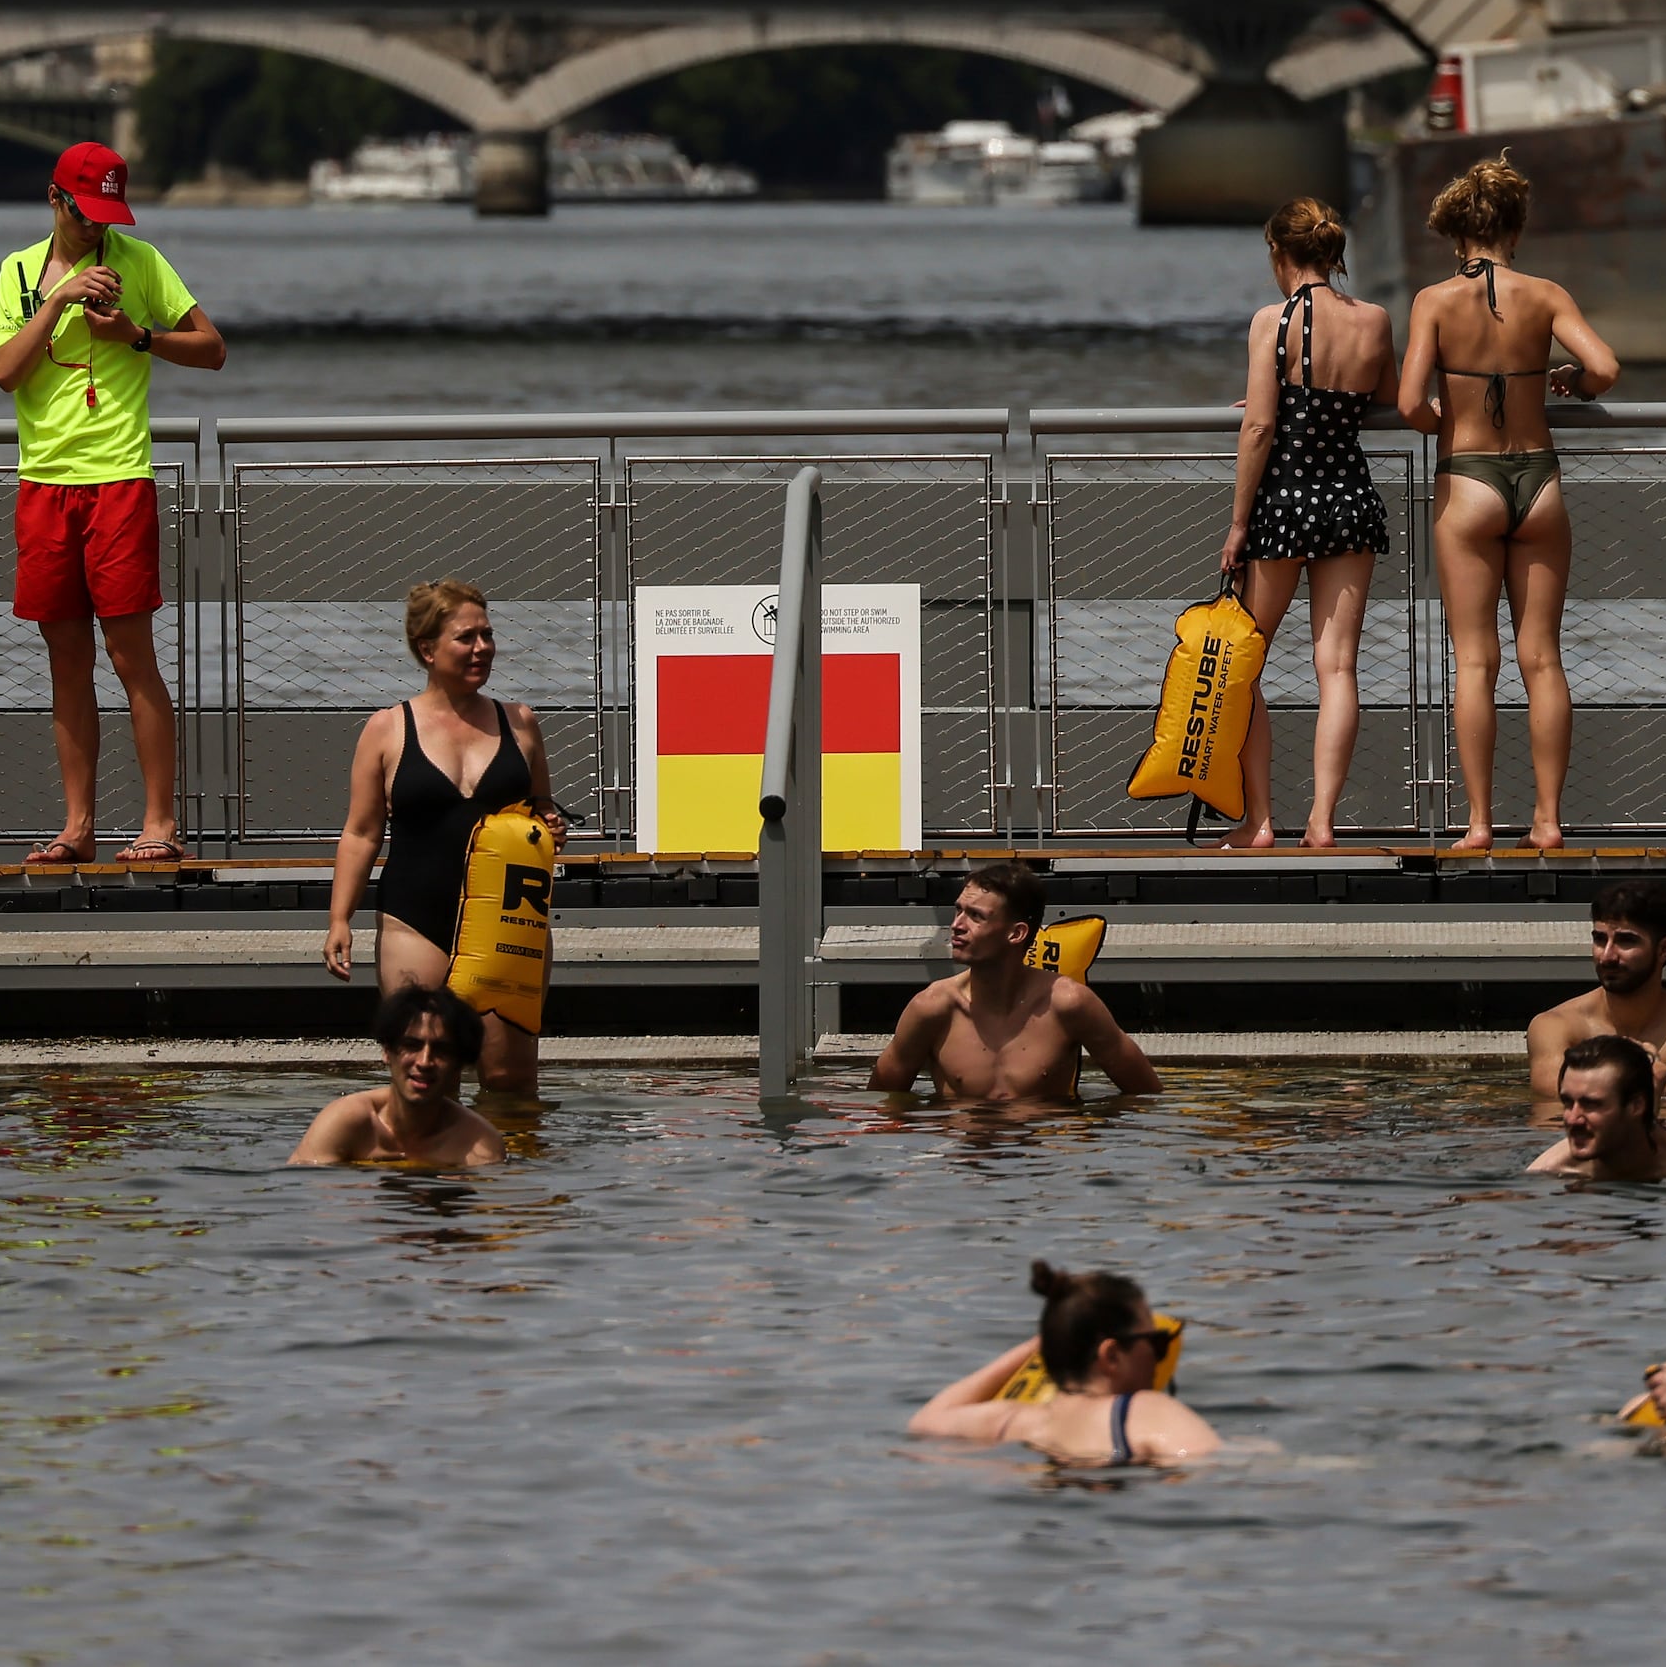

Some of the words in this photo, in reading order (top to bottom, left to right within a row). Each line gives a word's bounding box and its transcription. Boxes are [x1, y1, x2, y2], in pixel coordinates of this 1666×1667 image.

[655, 609, 664, 618] NE
[665, 609, 678, 618] PAS
[678, 609, 702, 618] SORTIR
[702, 609, 711, 617] DE
[829, 608, 842, 617] NOT
[843, 608, 860, 617] STEP
[860, 608, 870, 617] OR
[870, 608, 888, 616] SWIM
[655, 618, 664, 626] LA
[665, 618, 682, 626] ZONE
[682, 618, 691, 626] DE
[692, 617, 724, 626] BAIGNADE
[847, 617, 859, 625] THE
[860, 616, 901, 625] AUTHORIZED
[688, 626, 696, 635] ET
[697, 625, 734, 634] SURVEILLÉE
[852, 625, 870, 634] AREA
[1198, 736, 1215, 781] SMART
[1207, 690, 1225, 735] WATER
[1217, 639, 1235, 690] SAFETY
[497, 943, 525, 955] SWIM
